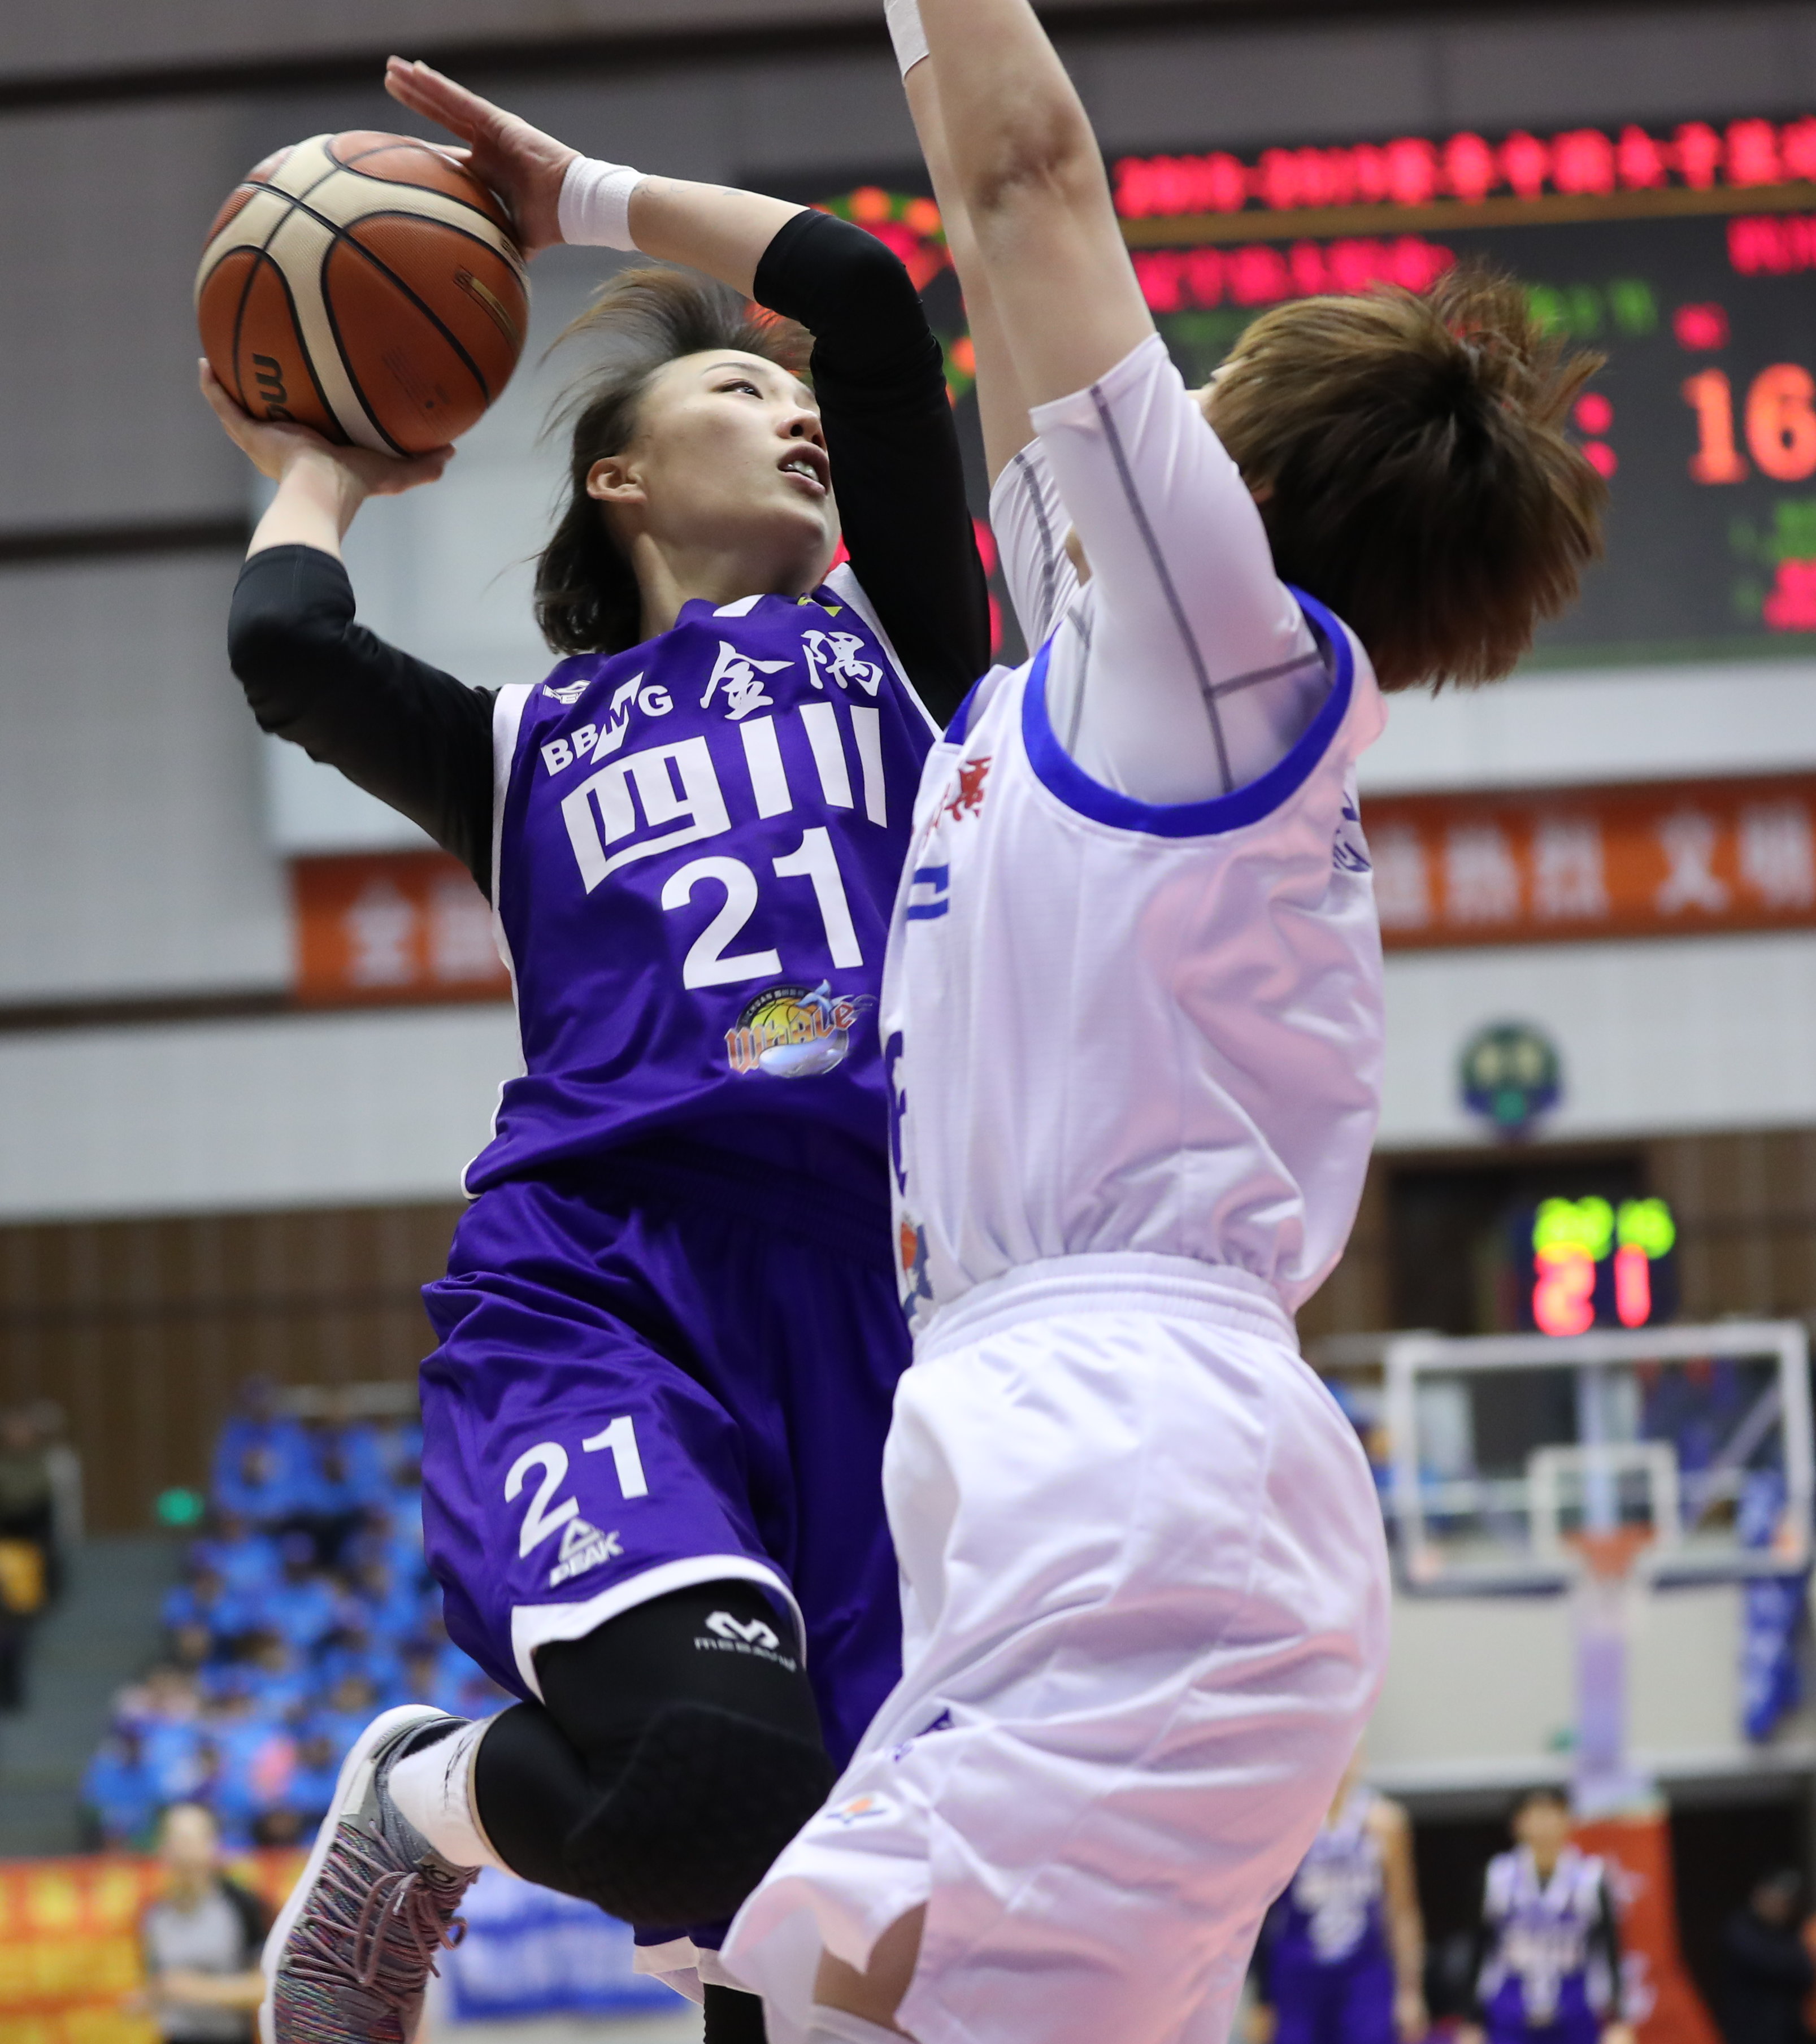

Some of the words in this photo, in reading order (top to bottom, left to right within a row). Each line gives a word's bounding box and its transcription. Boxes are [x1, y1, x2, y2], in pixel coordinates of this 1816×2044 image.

[541, 671, 674, 777] BBMG
[700, 629, 883, 720] 金隅
[561, 701, 888, 895] 四川
[661, 826, 863, 990] 21
[504, 1415, 649, 1559] 21
